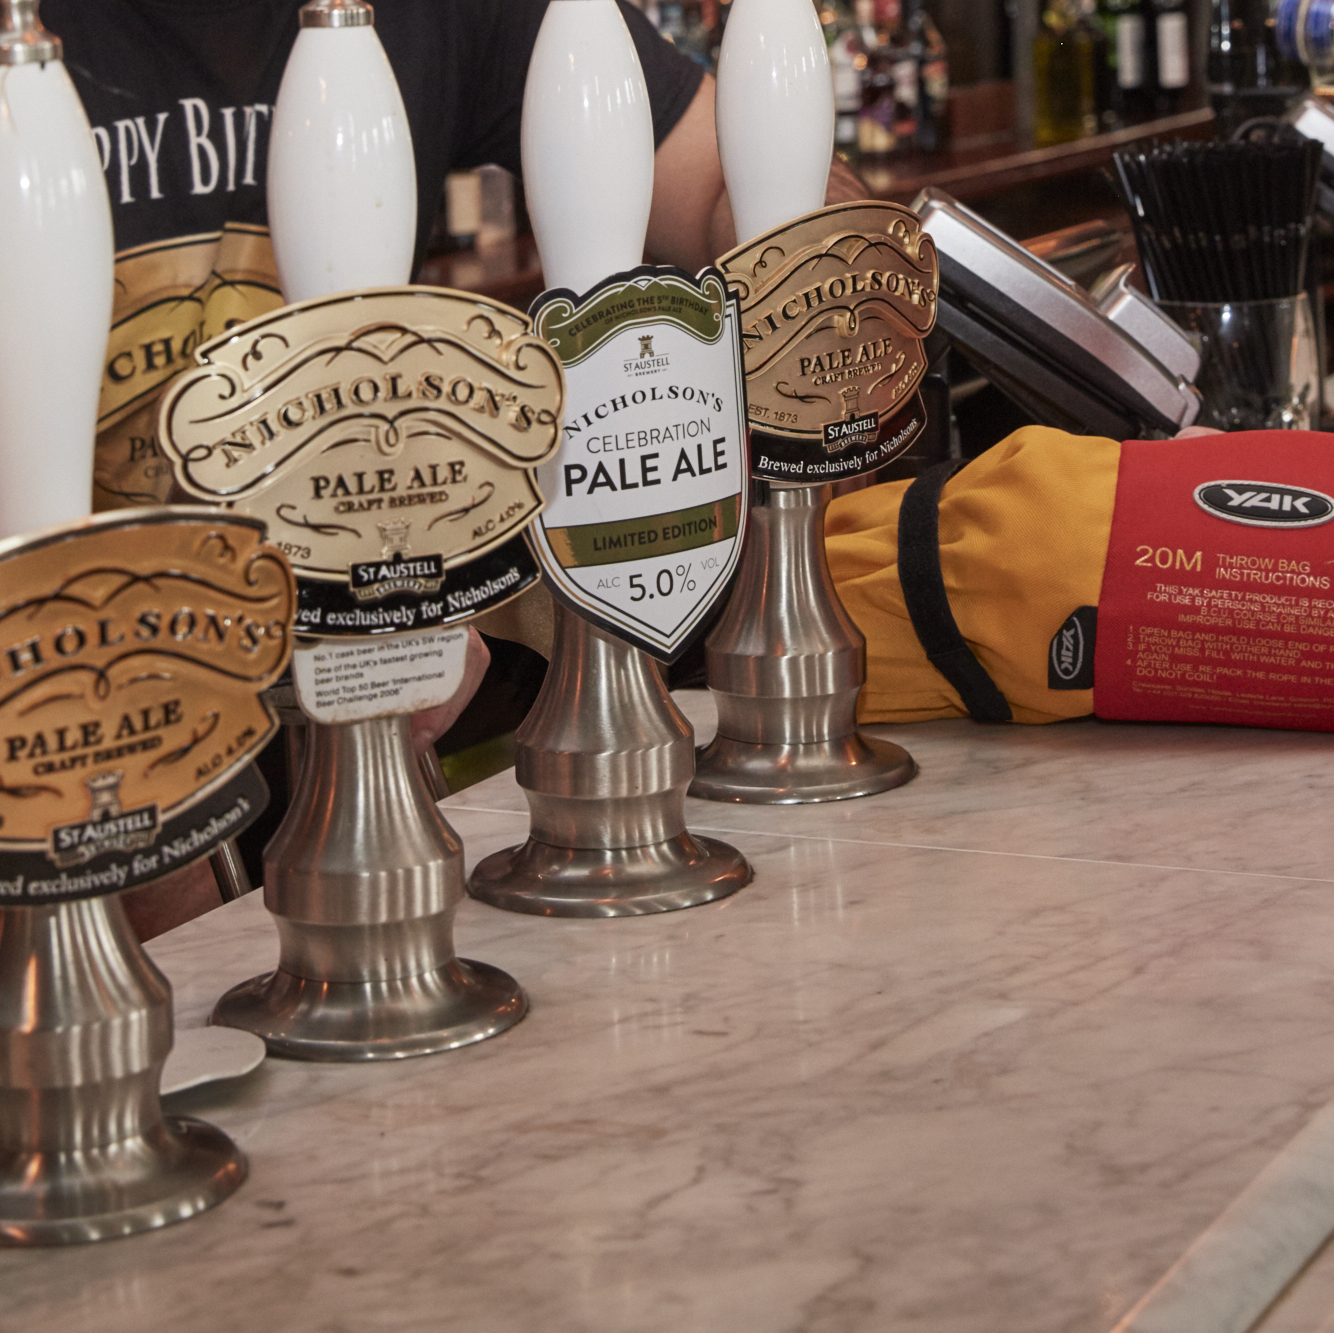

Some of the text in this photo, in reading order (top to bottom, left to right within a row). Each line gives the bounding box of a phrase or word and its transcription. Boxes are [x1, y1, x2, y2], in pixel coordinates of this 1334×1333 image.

[568, 298, 635, 337] CELEBRATING
[636, 296, 655, 307] THE
[670, 295, 709, 315] BIRTHDAY
[614, 306, 657, 321] NICHOLSON'S
[657, 306, 672, 315] PALE
[742, 271, 928, 352] NICHOLSON'S
[633, 356, 671, 371] AUSTELL
[799, 338, 892, 377] PALE ALE
[635, 368, 661, 377] BREWERY
[814, 363, 882, 386] CRAFT BREWED
[213, 373, 536, 467] NICHOLSON'S
[563, 385, 723, 440] NICHOLSON'S
[748, 404, 798, 424] EST. 1873
[586, 417, 711, 454] CELEBRATION
[840, 417, 876, 435] AUSTELL
[758, 418, 918, 474] Brewed exclusively for Nicholson's
[311, 461, 467, 499] PALE ALE
[564, 437, 728, 497] PALE ALE
[335, 490, 448, 514] CRAFT BREWED
[1221, 488, 1312, 514] YAK
[471, 519, 496, 540] ALC
[593, 516, 717, 551] LIMITED EDITION
[276, 542, 311, 559] 1873
[1134, 545, 1203, 572] 20M
[1217, 553, 1311, 573] THROW BAG
[378, 562, 437, 578] AUSTELL
[597, 557, 720, 602] ALC 5.0% VOL
[1216, 567, 1330, 590] INSTRUCTIONS
[327, 605, 415, 626] exclusively
[421, 600, 443, 619] for
[447, 567, 520, 613] Nicholson's
[1148, 591, 1169, 603] FOR
[1172, 594, 1191, 605] USE
[1195, 597, 1209, 607] BY
[1212, 598, 1261, 611] PERSONS
[1264, 603, 1310, 616] TRAINED
[1312, 607, 1325, 617] BY
[1156, 583, 1178, 595] THIS
[1181, 586, 1201, 597] YAK
[1204, 589, 1243, 601] SAFETY
[1246, 592, 1296, 605] PRODUCT
[1299, 597, 1309, 607] IS
[1179, 614, 1232, 627] IMPROPER
[1236, 618, 1256, 629] USE
[1260, 621, 1281, 632] CAN
[1284, 623, 1297, 633] BE
[1234, 609, 1277, 622] COURSE
[1280, 613, 1296, 623] OR
[335, 649, 355, 660] cask
[356, 647, 376, 656] beer
[386, 641, 400, 650] the
[401, 639, 420, 648] UK's
[421, 636, 435, 645] SW
[437, 632, 464, 643] region
[1060, 627, 1076, 673] YAK
[1139, 626, 1168, 636] OPEN
[1171, 629, 1192, 640] BAG
[1194, 631, 1216, 642] AND
[1219, 633, 1247, 644] HOLD
[1250, 636, 1286, 648] LOOSE
[1288, 639, 1310, 650] END
[1313, 642, 1326, 653] OF
[1139, 635, 1267, 654] THROW BAG WITH OTHER
[334, 663, 342, 671] of
[343, 661, 357, 670] the
[379, 654, 408, 665] fastest
[409, 649, 443, 662] growing
[1139, 643, 1148, 652] IF
[1150, 644, 1172, 655] YOU
[1205, 649, 1225, 660] FILL
[1231, 652, 1257, 663] WITH
[1260, 654, 1296, 666] WATER
[1300, 658, 1322, 670] AND
[315, 671, 364, 685] beer brands
[1137, 659, 1170, 670] AFTER
[1199, 665, 1244, 677] RE-PACK
[1247, 669, 1266, 680] THE
[1269, 672, 1297, 683] ROPE
[1301, 675, 1311, 684] IN
[1314, 676, 1334, 686] THE
[1137, 667, 1217, 683] DO NOT COIL!
[315, 687, 340, 697] World
[342, 685, 357, 695] Top
[358, 683, 369, 691] 50
[370, 680, 390, 689] Beer
[316, 699, 335, 709] Beer
[336, 692, 378, 705] Challenge
[6, 699, 184, 763] PALE ALE
[81, 812, 153, 843] AUSTELL
[27, 864, 128, 896] exclusively
[132, 854, 159, 876] for
[162, 798, 251, 864] Nicholson's
